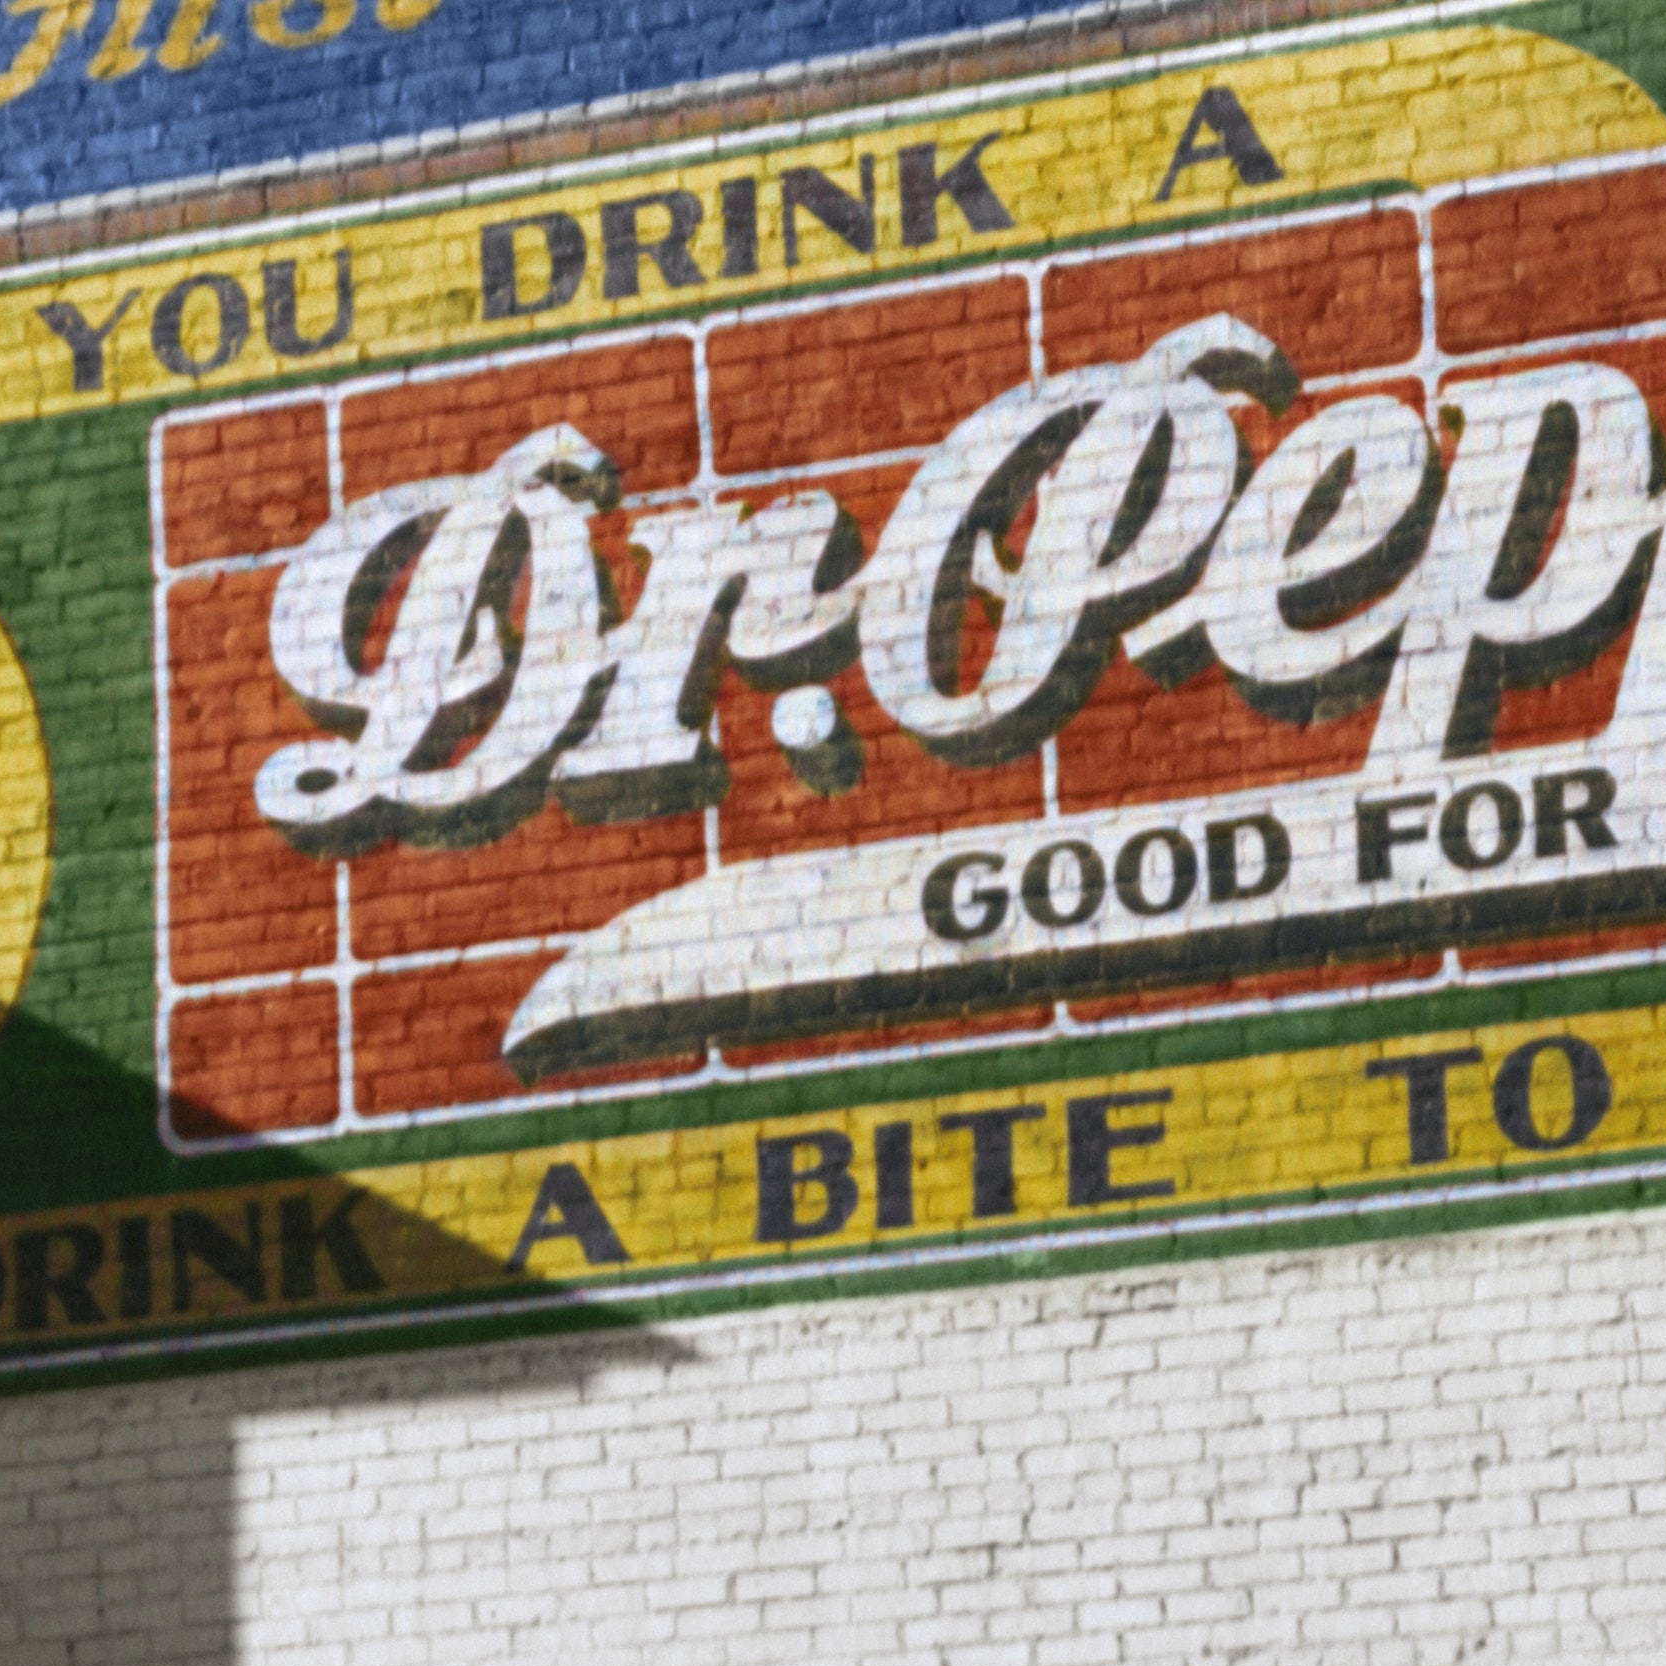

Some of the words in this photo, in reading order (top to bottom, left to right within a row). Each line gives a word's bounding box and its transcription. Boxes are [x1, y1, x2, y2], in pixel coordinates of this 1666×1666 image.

[35, 249, 351, 392] YOU
[478, 131, 1018, 320] DRINK
[1157, 85, 1283, 200] A
[922, 813, 1289, 941] GOOD
[1354, 766, 1620, 883] FOR
[505, 1163, 631, 1274] A
[756, 1088, 1177, 1244] BITE
[1365, 1036, 1612, 1165] TO
